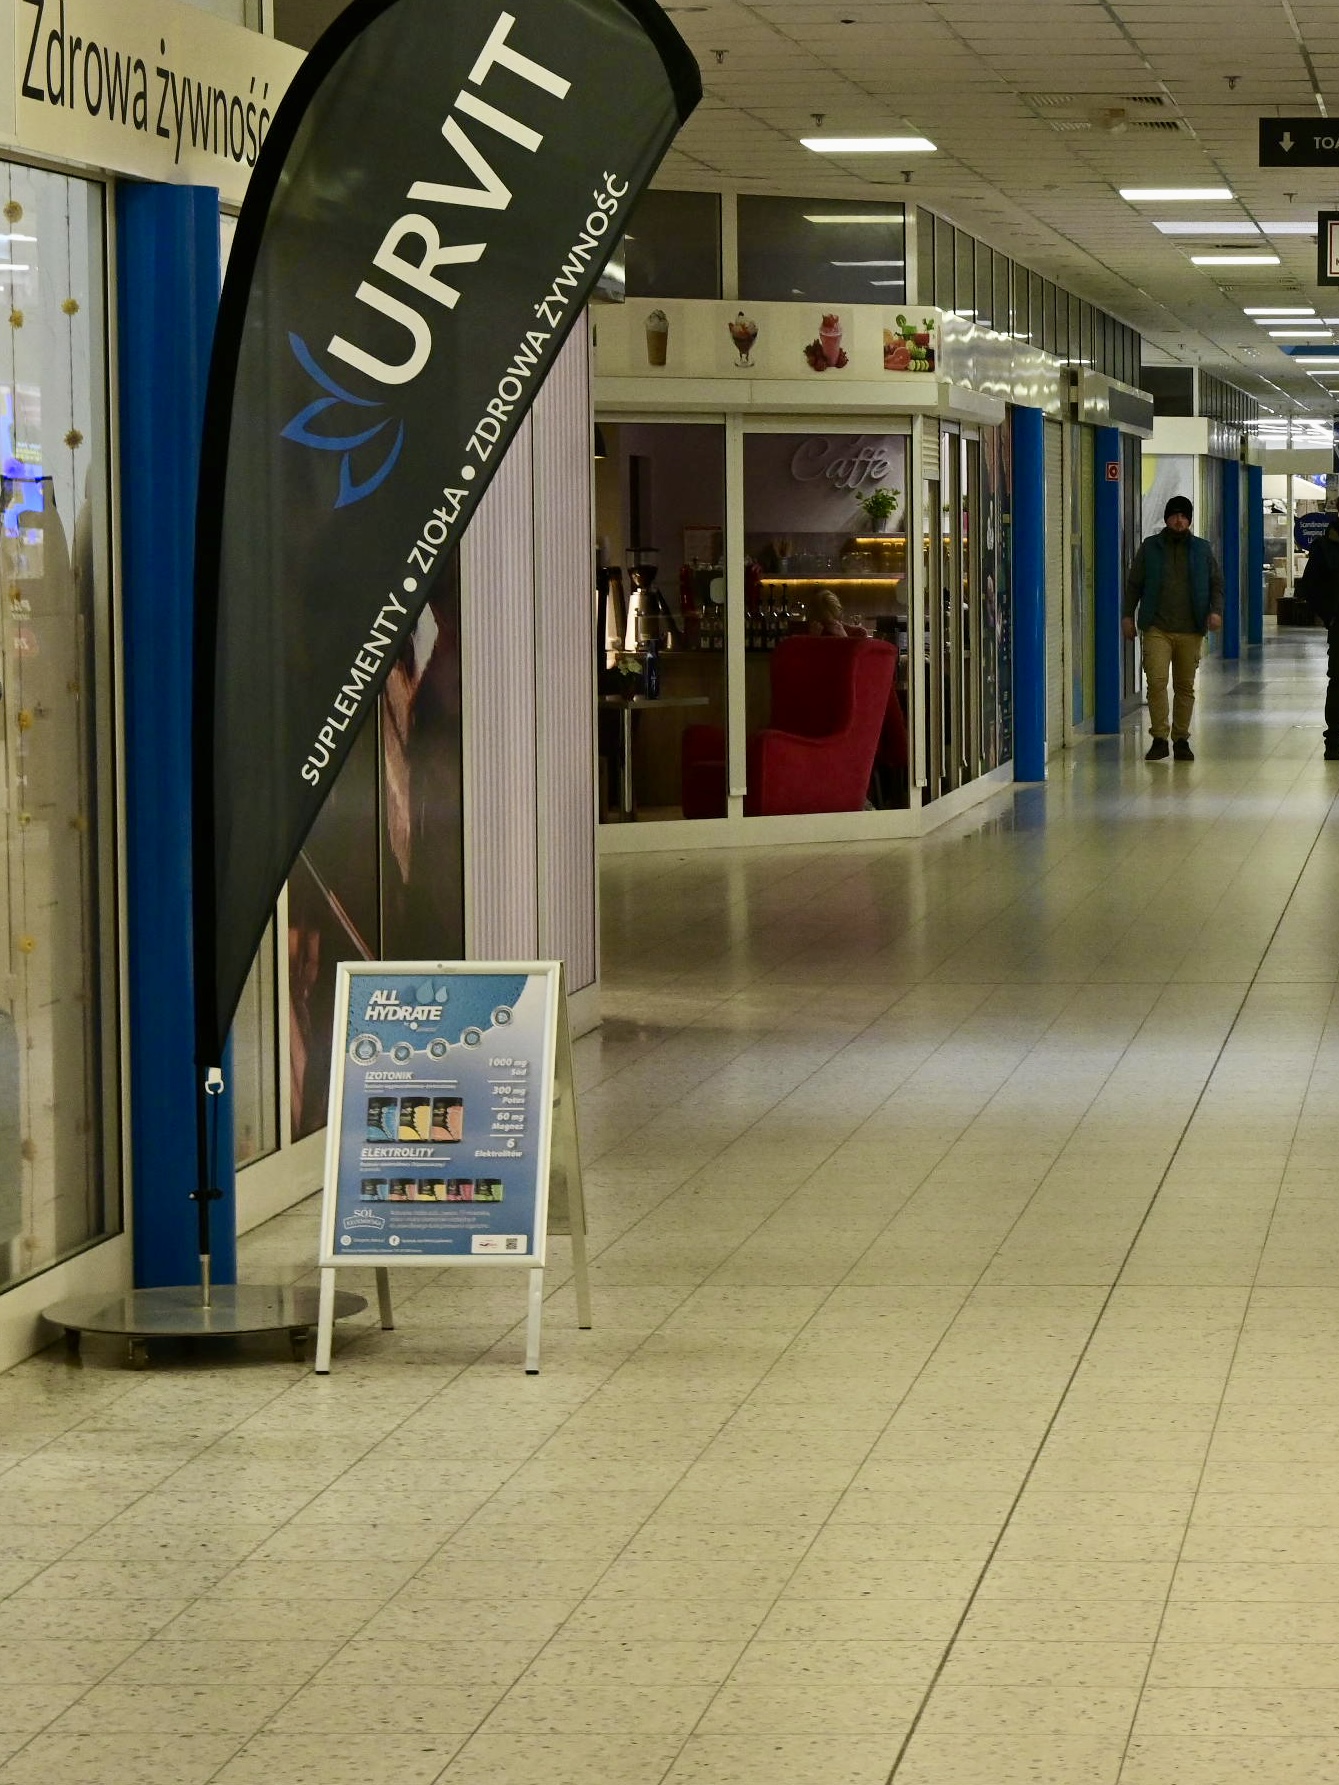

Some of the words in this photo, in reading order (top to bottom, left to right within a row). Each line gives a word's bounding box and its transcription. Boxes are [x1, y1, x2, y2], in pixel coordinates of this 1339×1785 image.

[22, 0, 147, 131] Zdrowa
[326, 10, 571, 386] URVIT
[301, 592, 408, 786] SUPLEMENTY
[407, 487, 469, 574] ZIOŁA
[466, 331, 550, 462] ZDROWA
[534, 171, 629, 328] ŻYWNOŚĆ
[369, 989, 400, 1005] ALL
[365, 1005, 443, 1021] HYDRATE
[488, 1058, 512, 1067] 1000
[513, 1060, 527, 1068] mg
[365, 1071, 413, 1080] IZOTONIK
[492, 1086, 511, 1095] 300
[512, 1088, 526, 1096] mg
[496, 1112, 510, 1121] 60
[511, 1114, 524, 1122] mg
[506, 1138, 516, 1148] 6
[361, 1148, 434, 1157] ELEKTROLITY
